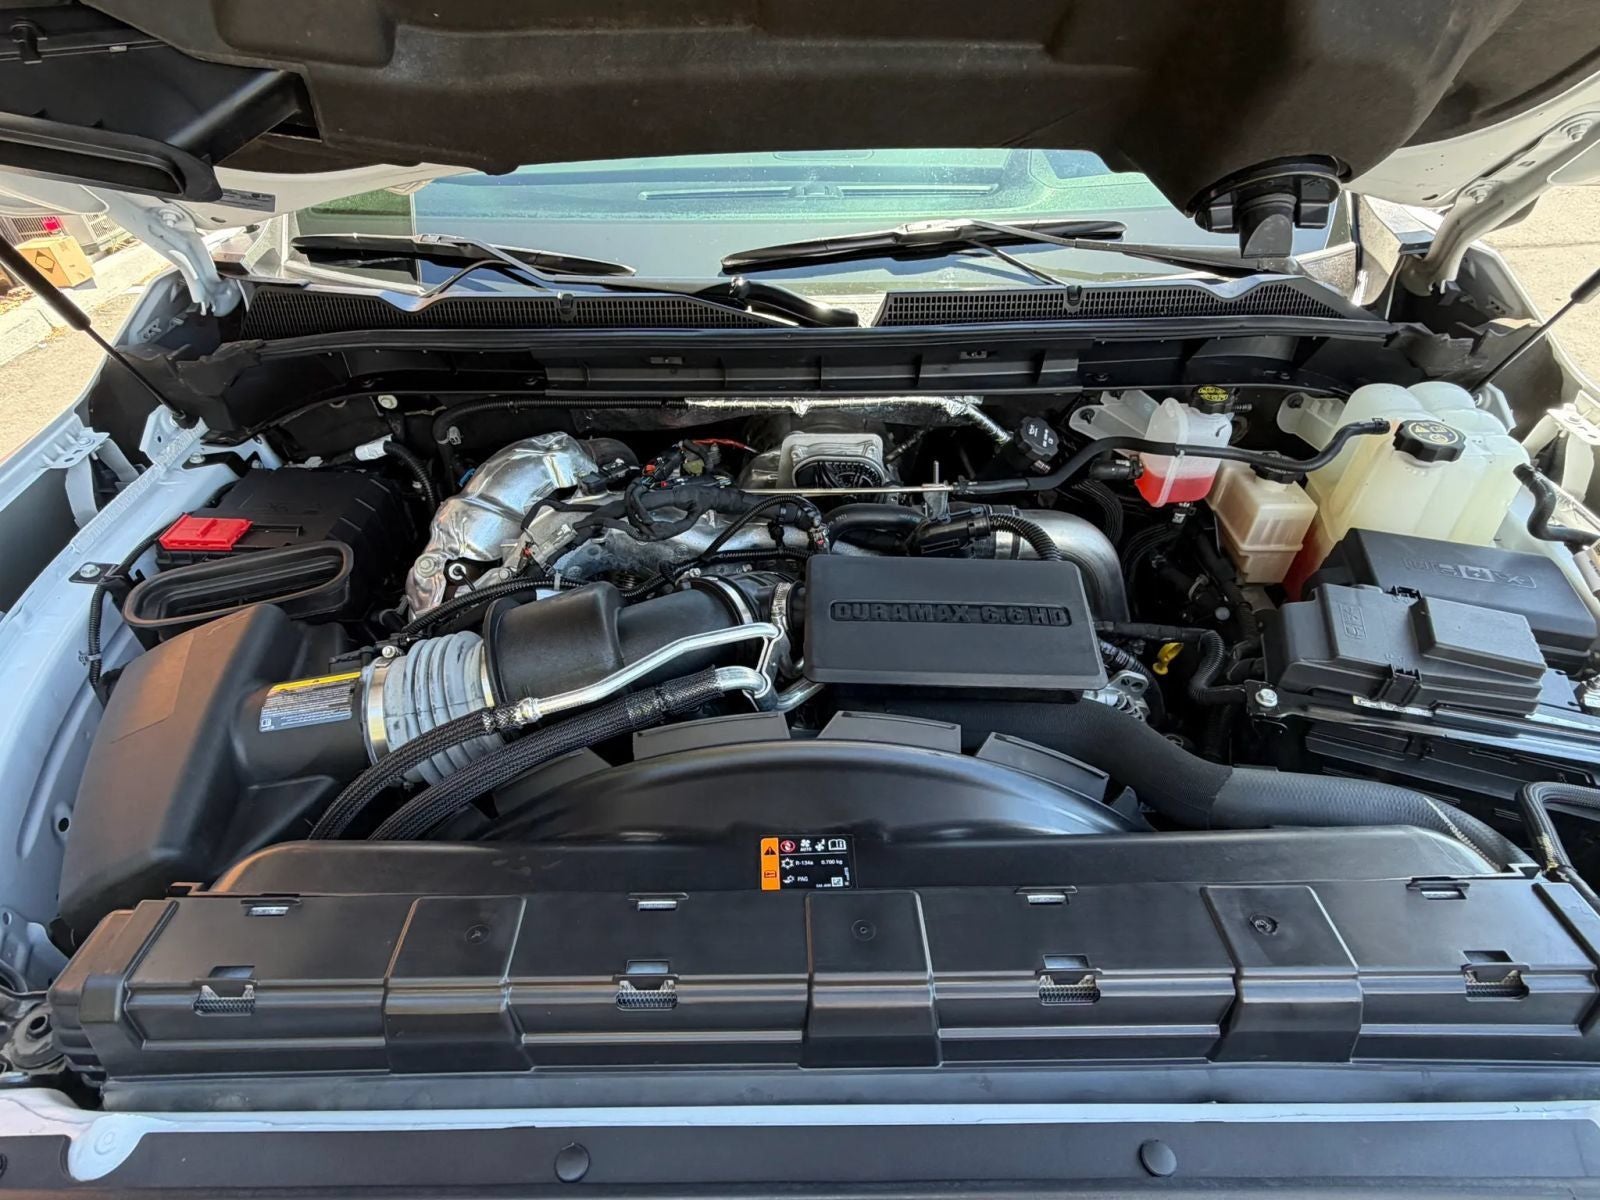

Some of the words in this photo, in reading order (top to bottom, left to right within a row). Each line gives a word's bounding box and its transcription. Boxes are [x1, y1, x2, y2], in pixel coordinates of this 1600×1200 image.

[834, 602, 970, 622] DURAMAX
[980, 604, 1026, 624] 6.6
[1028, 606, 1070, 626] HD
